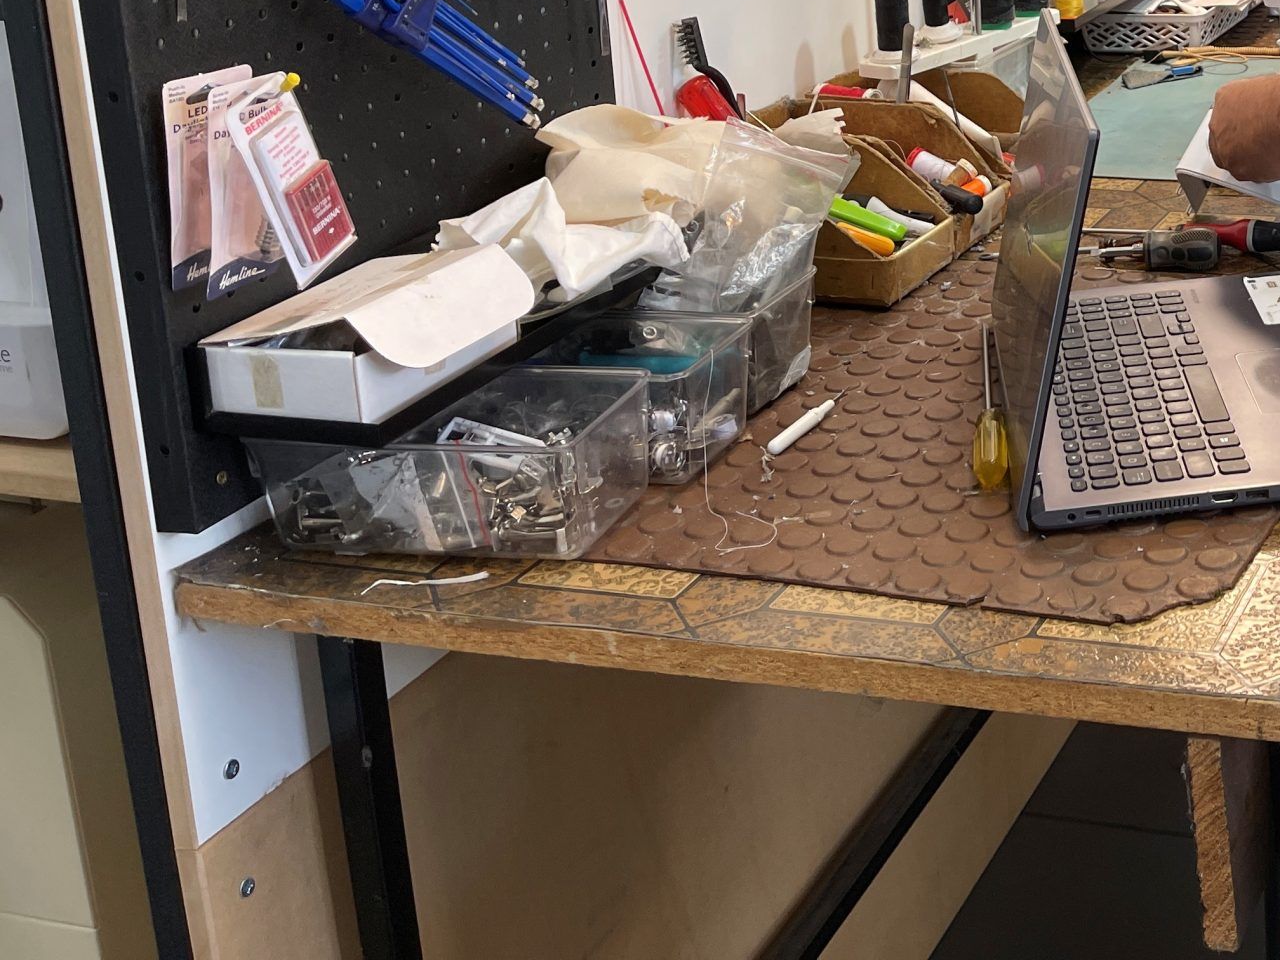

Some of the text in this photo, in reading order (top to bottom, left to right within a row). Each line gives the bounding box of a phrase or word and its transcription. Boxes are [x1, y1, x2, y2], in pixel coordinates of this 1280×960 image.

[188, 106, 208, 119] LED
[245, 104, 282, 135] BERNINA
[312, 207, 340, 235] BERNINA
[219, 266, 266, 289] Hemline
